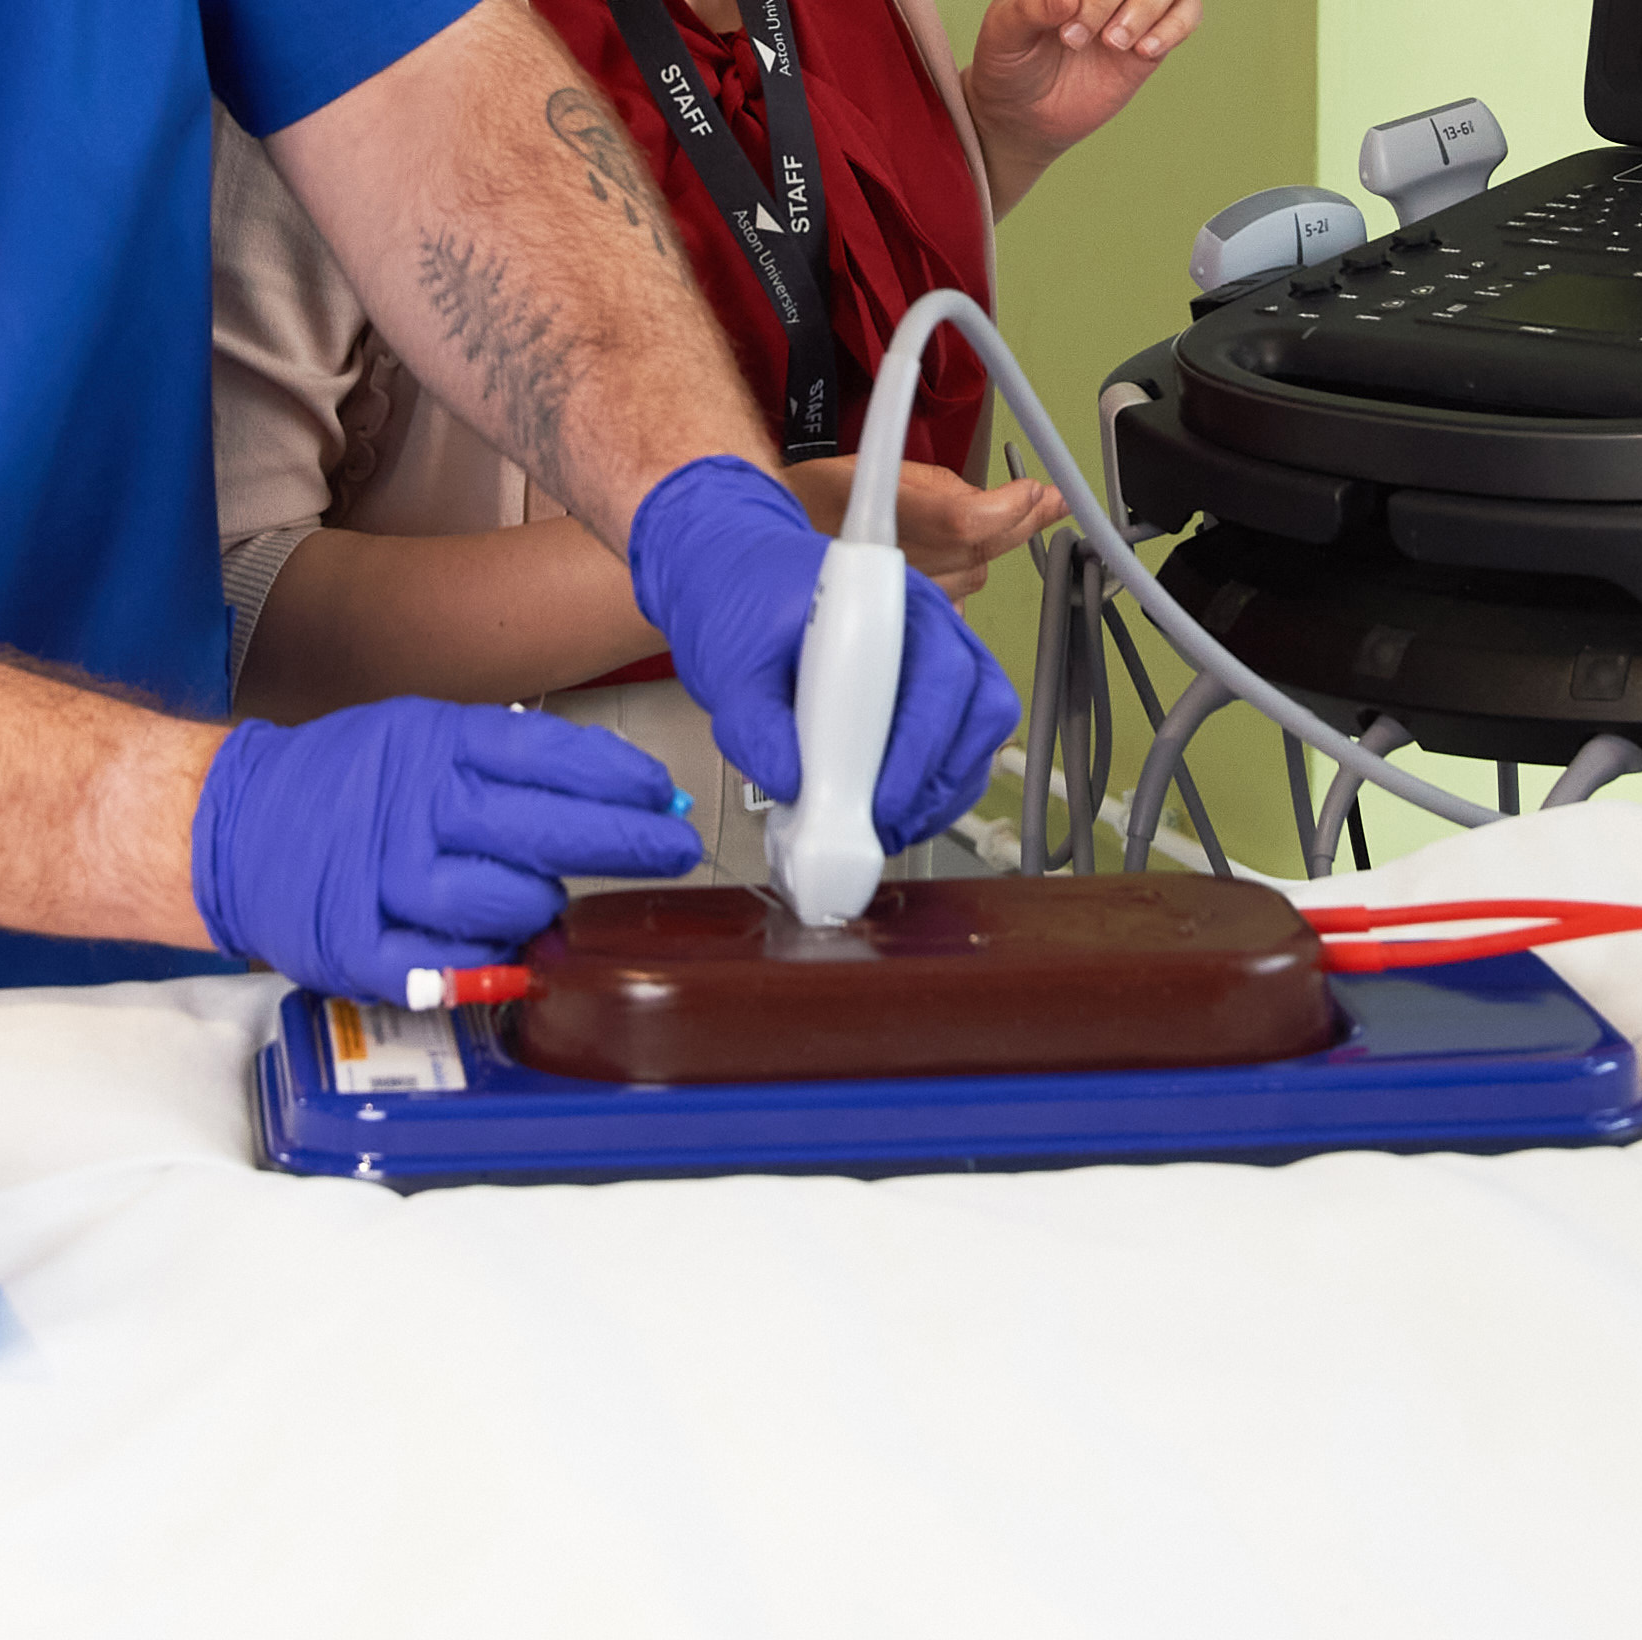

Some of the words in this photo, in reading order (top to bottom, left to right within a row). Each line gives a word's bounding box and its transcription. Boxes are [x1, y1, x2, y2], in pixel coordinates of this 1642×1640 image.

[773, 32, 792, 77] Aston
[660, 64, 713, 136] STAFF
[783, 155, 811, 234] STAFF
[733, 210, 764, 253] Aston
[759, 250, 800, 324] University
[803, 378, 824, 433] STAFF
